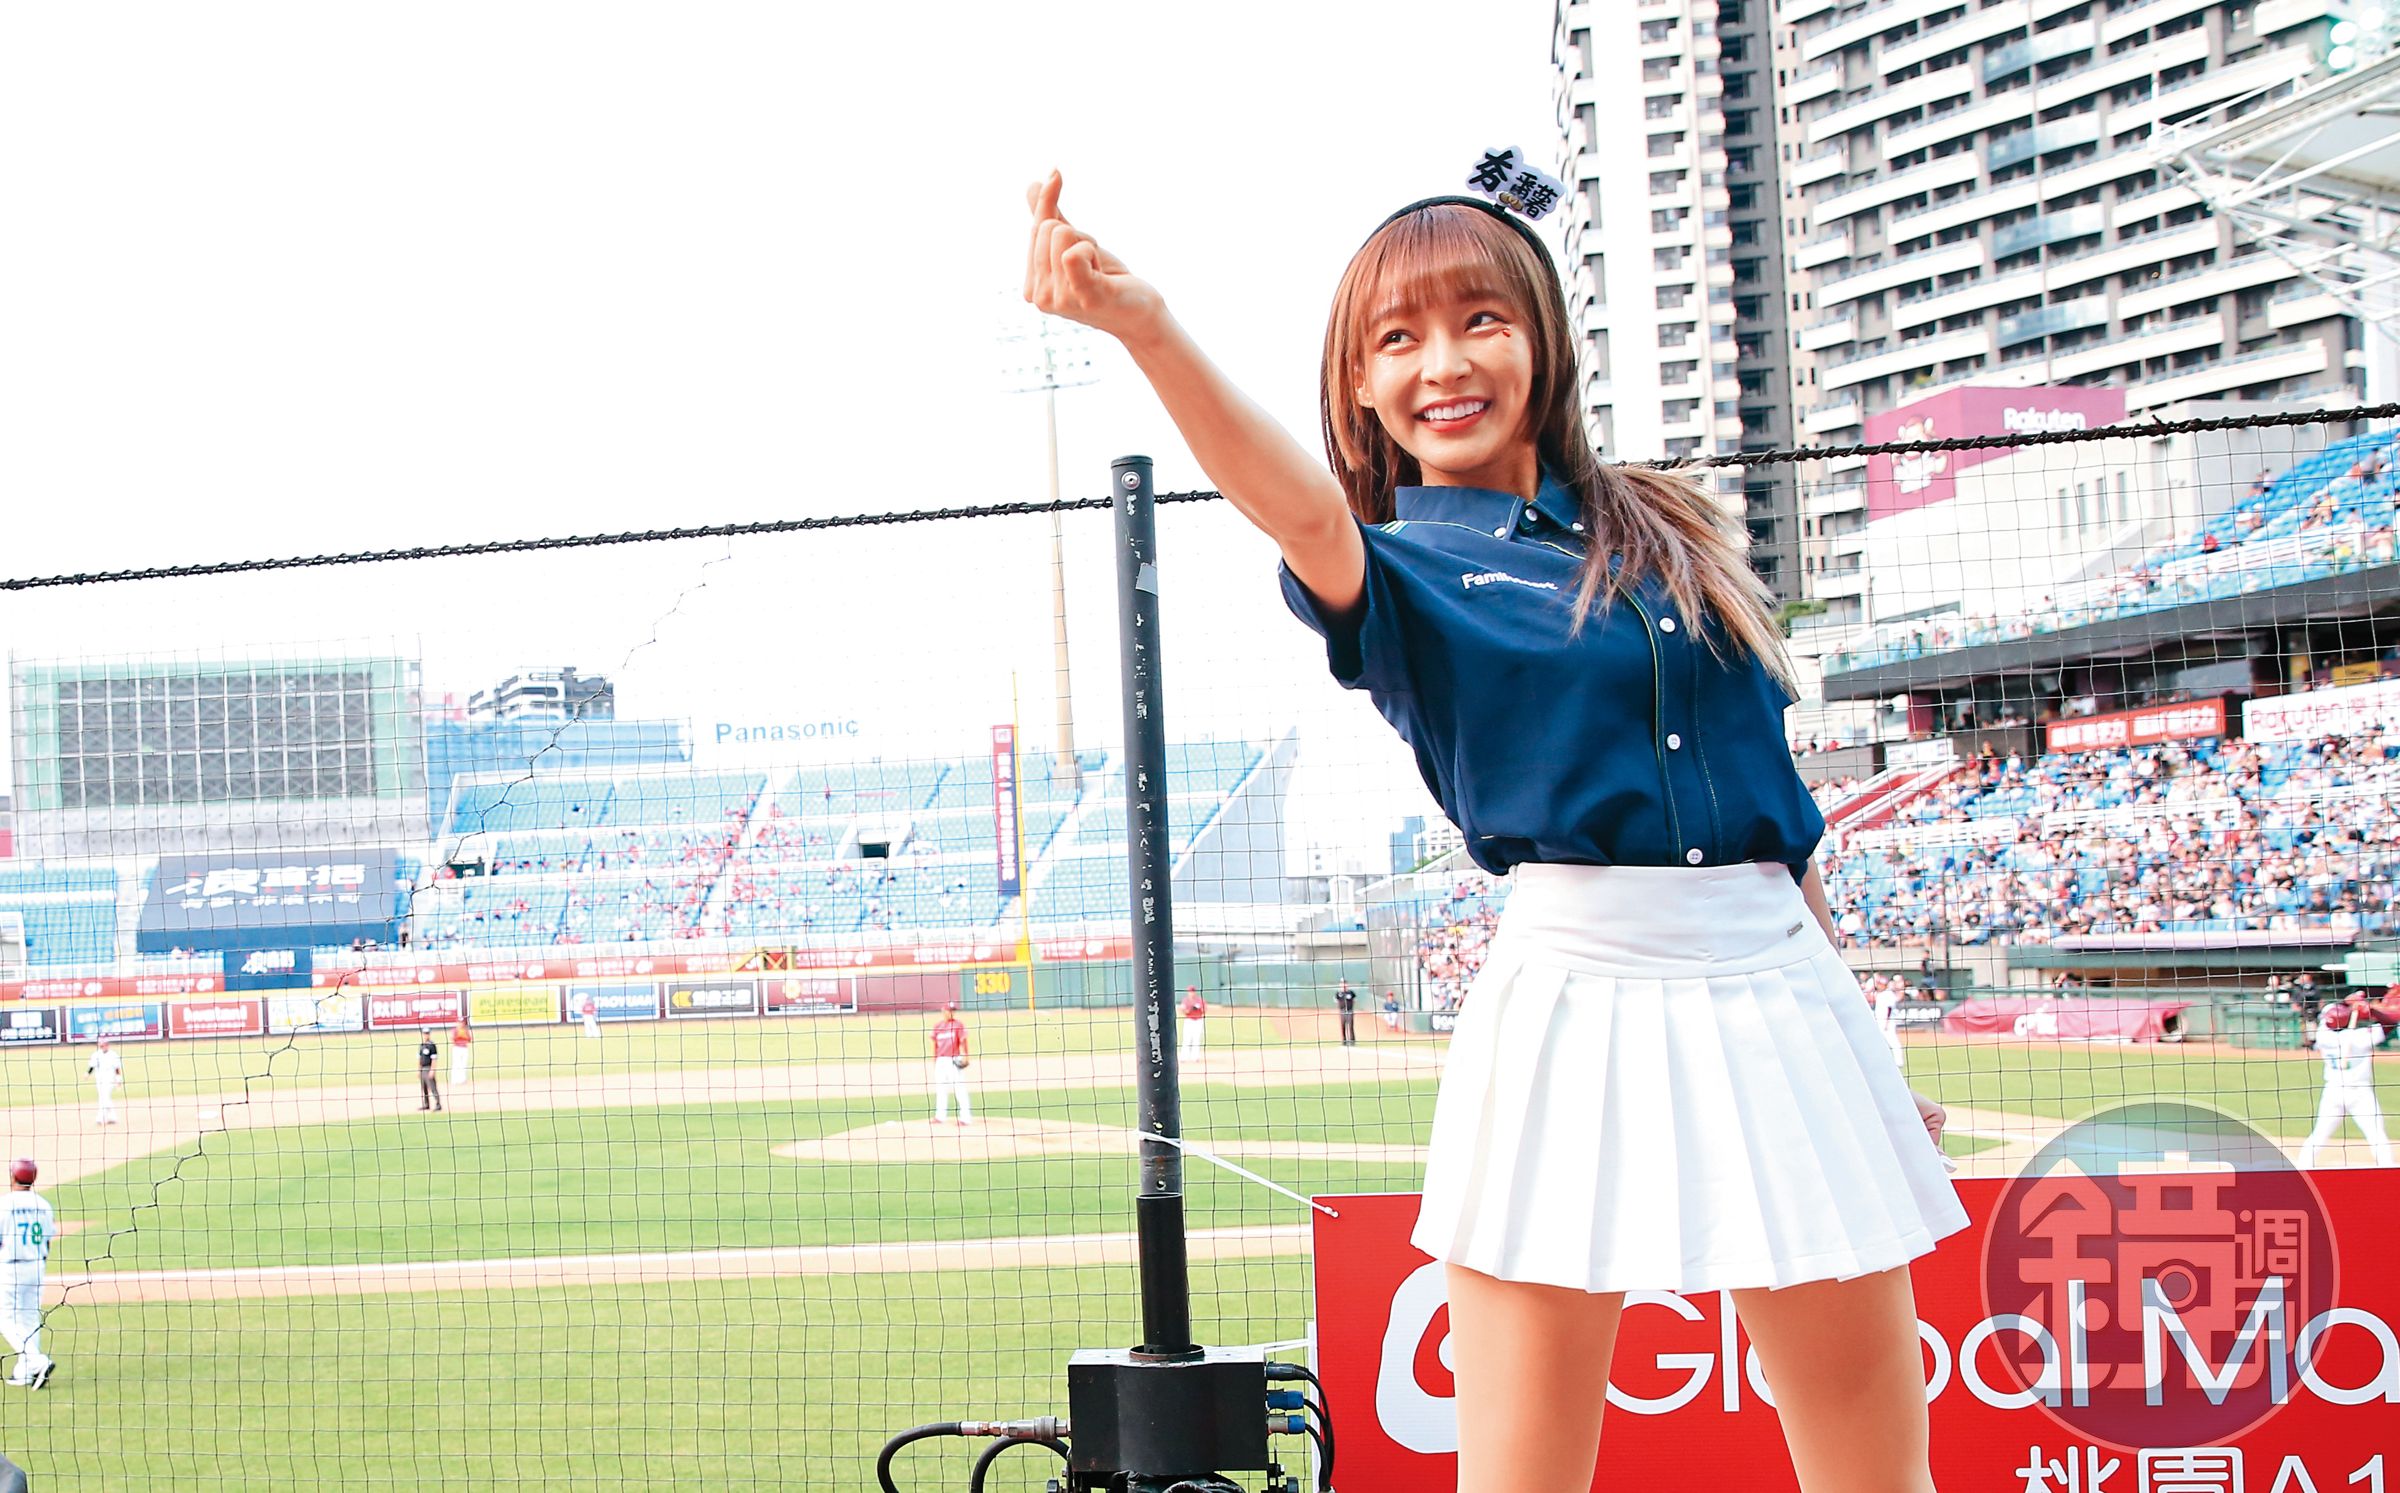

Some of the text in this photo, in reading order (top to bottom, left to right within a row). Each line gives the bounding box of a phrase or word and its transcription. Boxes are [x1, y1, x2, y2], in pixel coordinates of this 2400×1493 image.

[2003, 407, 2086, 430] Rakuten
[715, 718, 860, 744] Panasonic
[974, 971, 1012, 994] 330
[17, 1222, 43, 1245] 78
[1605, 1279, 2090, 1415] Glal
